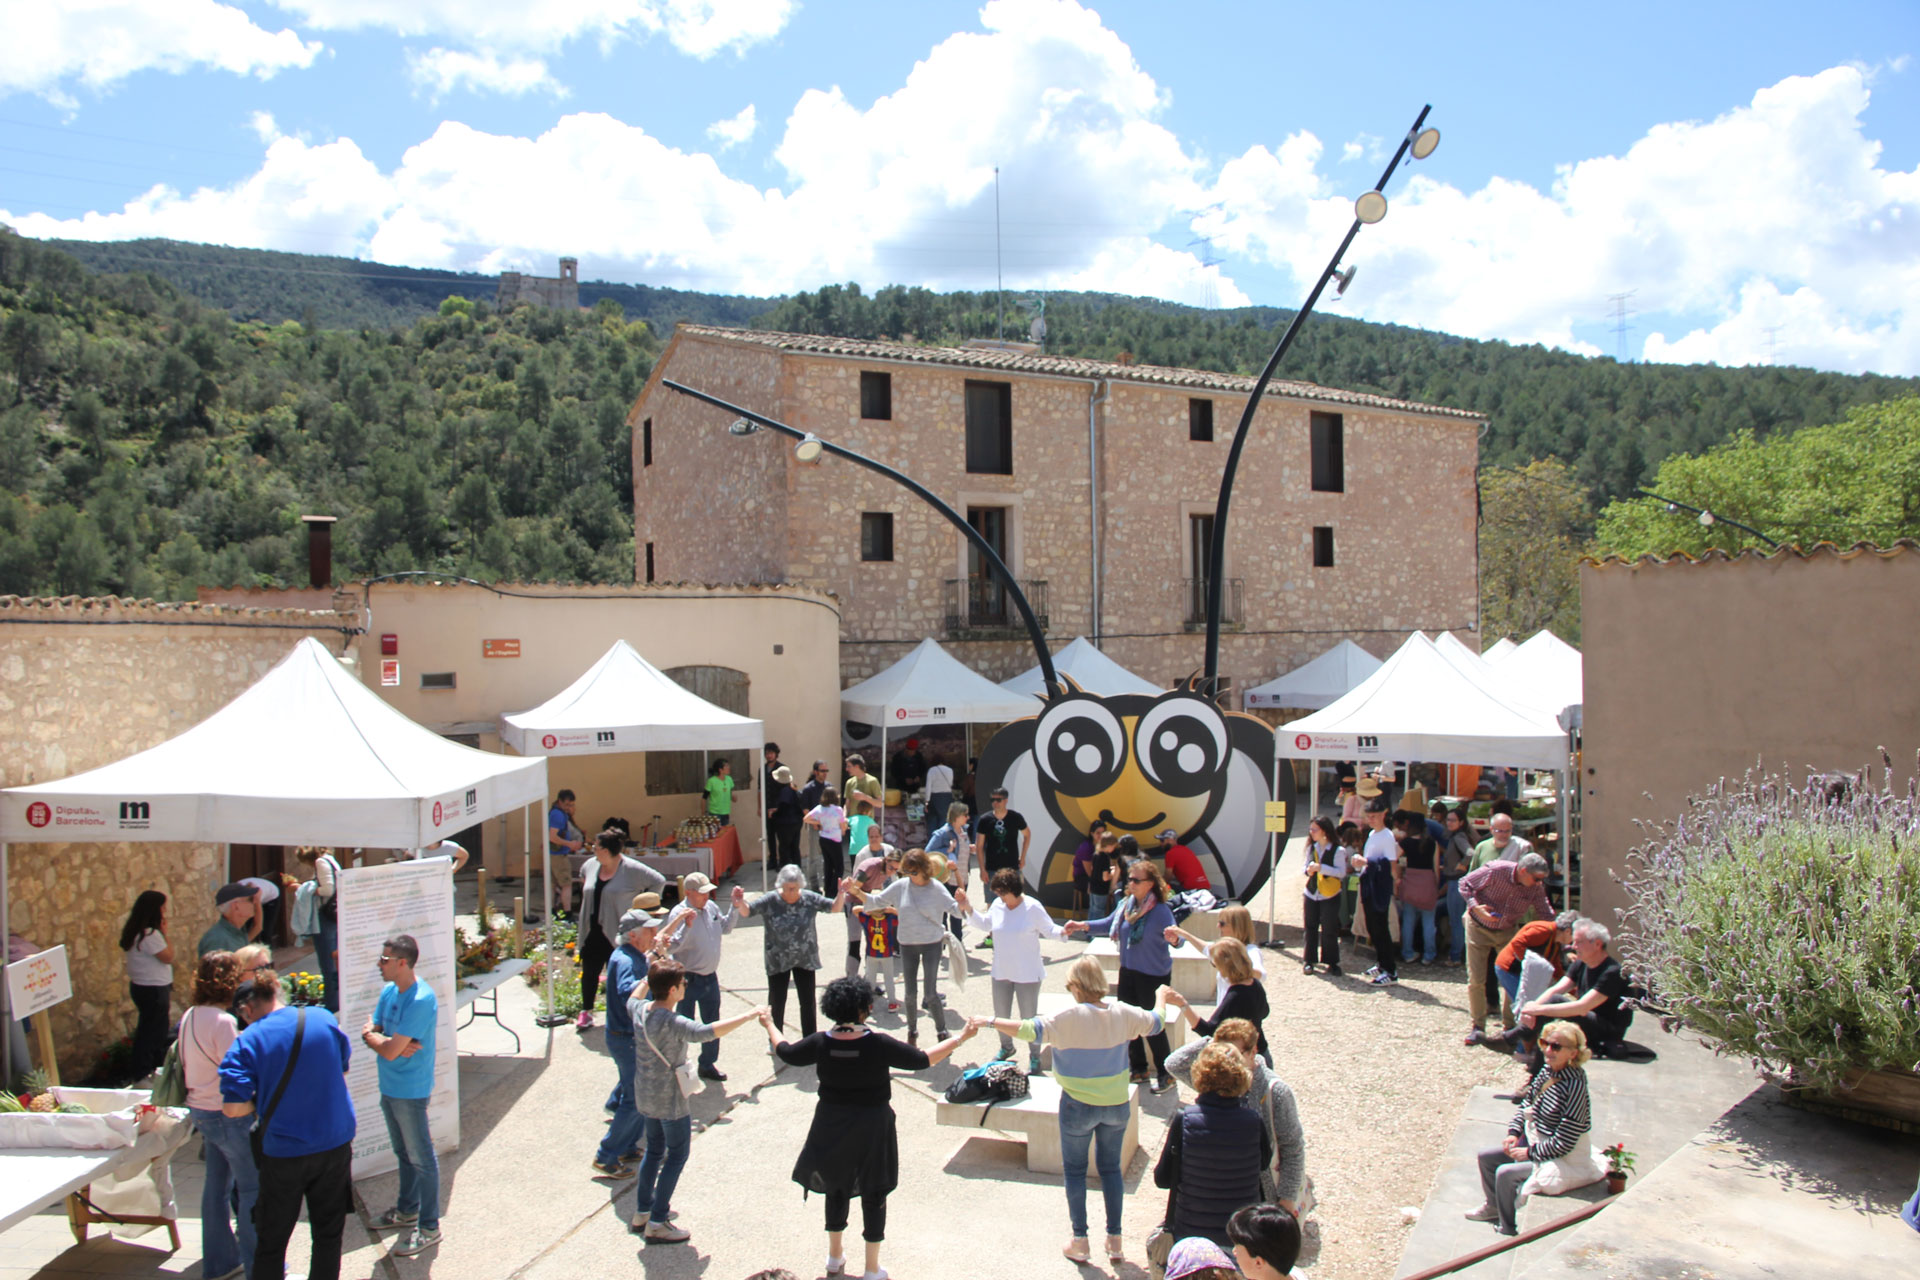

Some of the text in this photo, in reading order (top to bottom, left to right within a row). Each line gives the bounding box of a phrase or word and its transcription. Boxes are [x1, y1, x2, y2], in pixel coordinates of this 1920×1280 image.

[597, 731, 615, 742] m
[1357, 735, 1378, 747] m
[119, 801, 150, 820] m
[871, 934, 886, 953] 4
